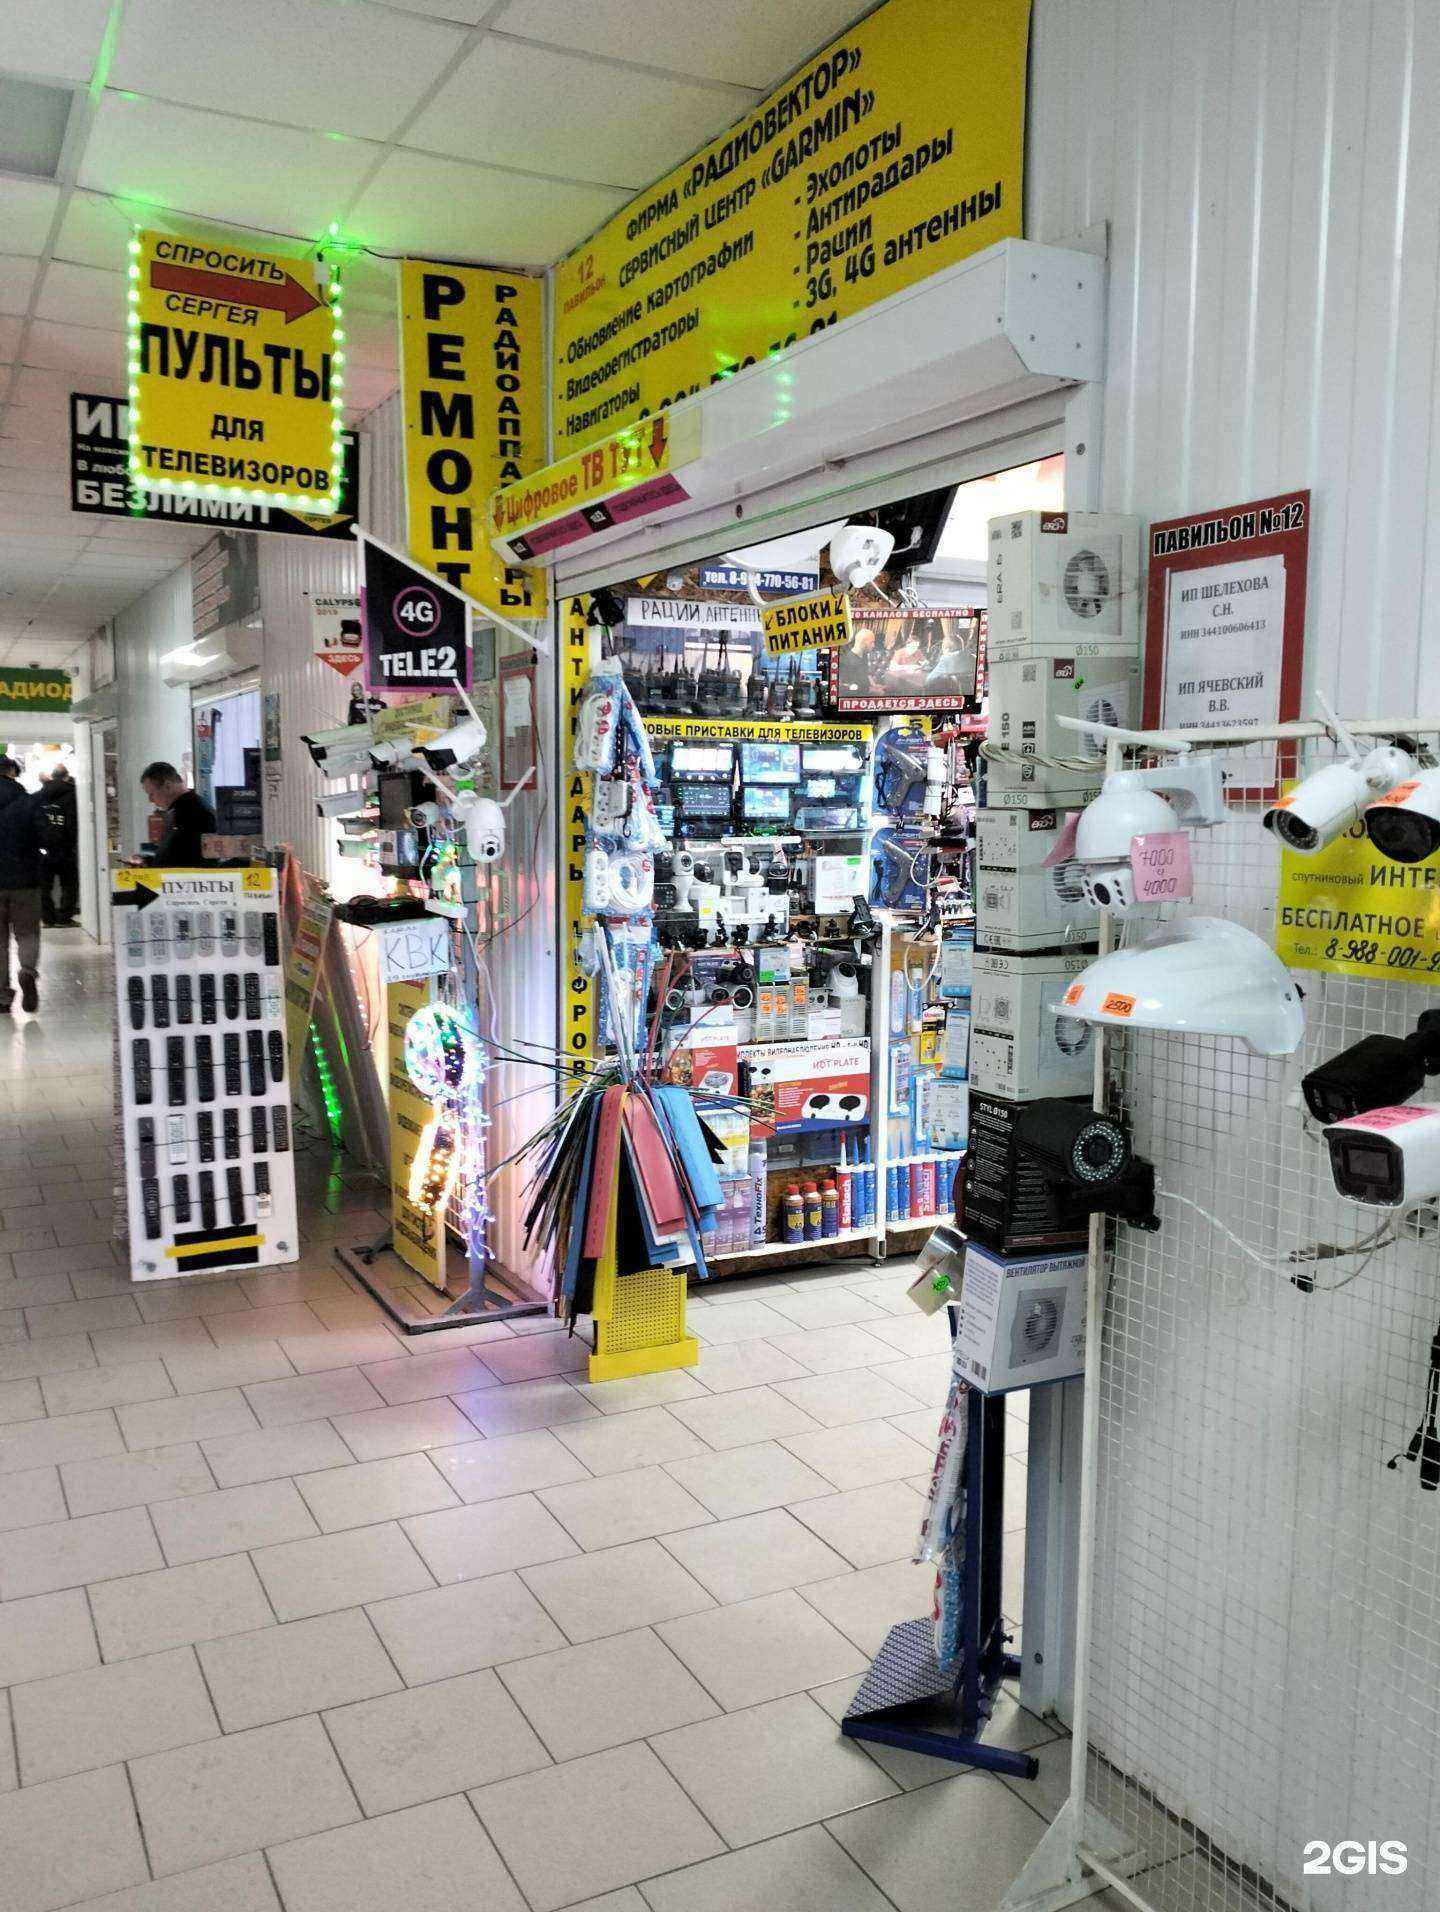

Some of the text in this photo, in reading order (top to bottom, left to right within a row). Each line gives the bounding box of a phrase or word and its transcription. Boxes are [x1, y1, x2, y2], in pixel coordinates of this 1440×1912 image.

[626, 46, 862, 241] ФИРМА «РАДИОВЕКТОР»
[806, 122, 901, 204] Эхолоты
[618, 90, 875, 288] СЕРВИСНЫЙ ЦЕНТР «GARMIN»
[806, 128, 953, 240] Антирадары
[806, 214, 873, 274] Рации
[844, 245, 875, 285] 4G
[883, 182, 1002, 266] антенны
[155, 241, 285, 281] СПРОСИТЬ
[165, 294, 260, 327] СЕРГЕЯ
[567, 298, 642, 364] Обновление
[646, 231, 754, 309] картографии
[140, 322, 331, 402] ПУЛЬТЫ
[566, 308, 699, 400] Видеорегистраторы
[565, 383, 641, 436] Навигаторы
[211, 413, 265, 442] ДЛЯ
[419, 273, 474, 590] РЕМОНТ
[143, 445, 329, 491] ТЕЛЕВИЗОРОВ
[507, 474, 578, 526] Цифровое
[581, 448, 604, 491] ТВ
[1153, 501, 1306, 557] ПАВИЛЬОН №12
[1181, 576, 1269, 602] ИП ШЕЛЕХОВА
[400, 601, 434, 623] 4G
[706, 606, 761, 623] АНТЕНН
[776, 600, 831, 627] БЛОКИ
[1212, 602, 1234, 617] С.Н.
[769, 622, 847, 652] ПИТАНИЯ
[1180, 628, 1200, 641] ИНН
[379, 646, 458, 677] TELE2
[1178, 671, 1264, 696] ИП ЯЧЕВСКИЙ
[843, 697, 959, 710] ПРОДАЕТСЯ ЗДЕСЬ
[1208, 698, 1230, 713] В.В.
[686, 724, 755, 738] ПРИСТАВКИ
[758, 727, 781, 740] ДЛЯ
[785, 728, 862, 741] ТЕЛЕВИЗОРОВ
[162, 880, 234, 894] ПУЛЬТЫ
[1370, 865, 1437, 889] ИНТЕ
[1281, 907, 1425, 938] БЕСПЛАТНОЕ
[1325, 936, 1440, 972] 8-988-001-9
[834, 1057, 860, 1068] PLATE
[1005, 1263, 1049, 1278] ВЕНТИЛЯТОР
